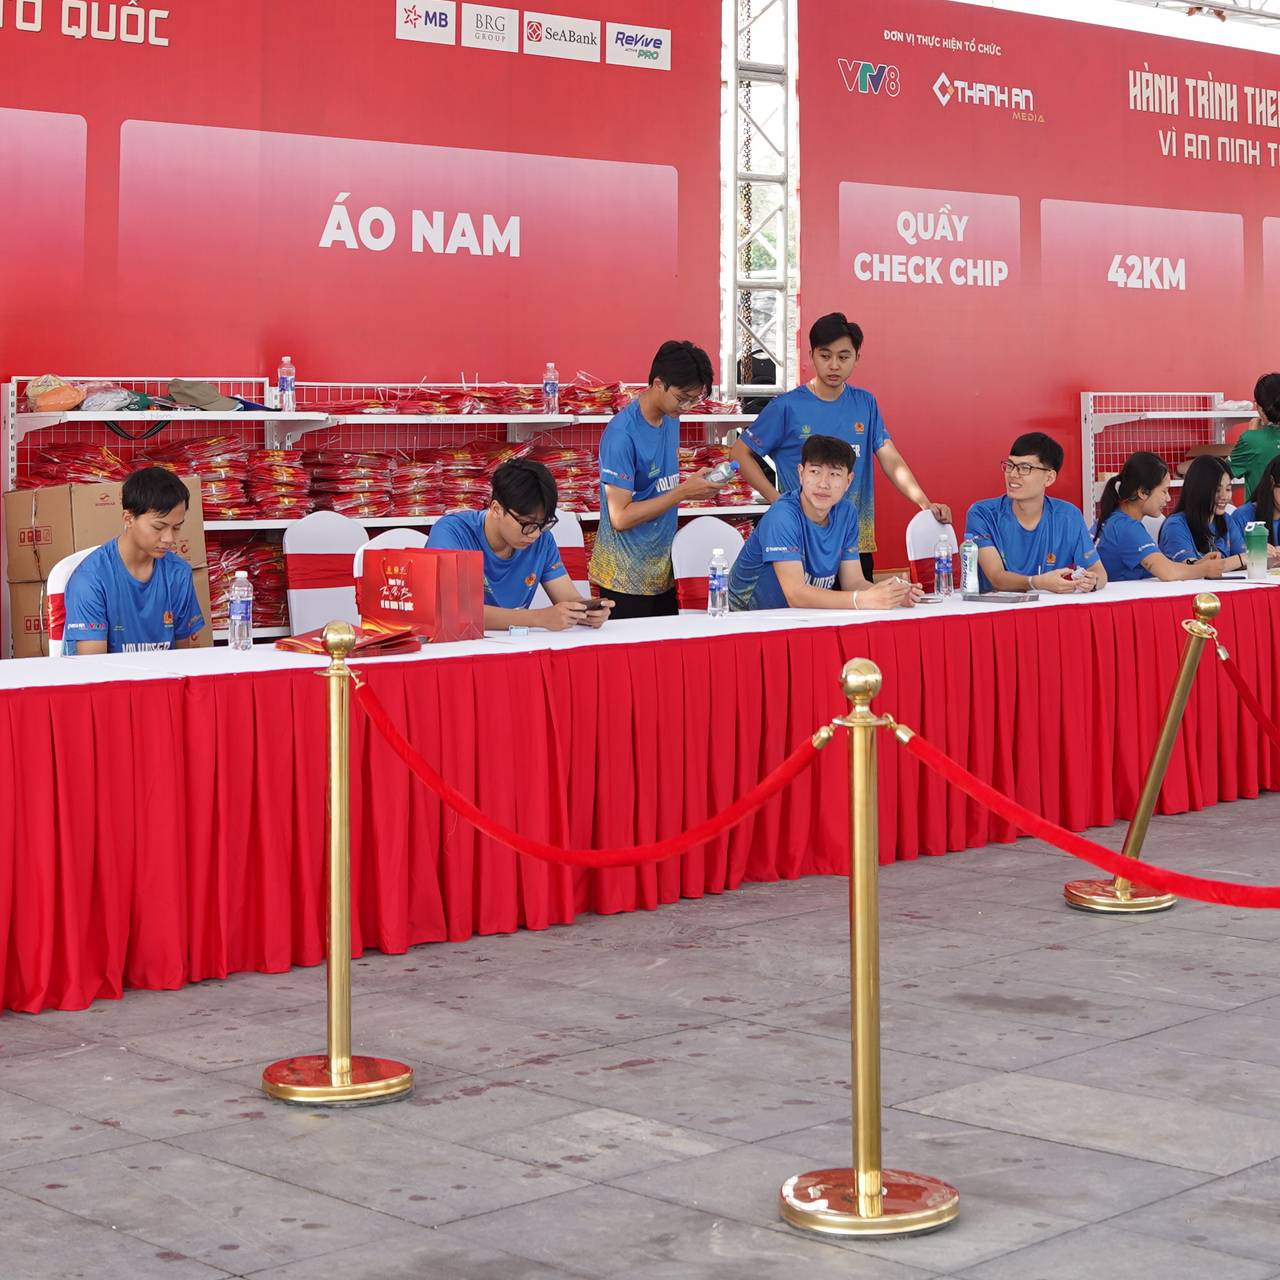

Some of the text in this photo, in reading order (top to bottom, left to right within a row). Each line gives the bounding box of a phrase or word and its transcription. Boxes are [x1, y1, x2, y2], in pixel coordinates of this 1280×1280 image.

[424, 10, 448, 28] MB
[475, 14, 505, 32] BRG
[545, 27, 597, 46] SeABank
[884, 30, 903, 41] ĐƠN
[917, 34, 941, 48] THỰC
[942, 37, 962, 52] HIỆN
[964, 37, 976, 52] TỔ
[978, 41, 1002, 56] CHỨC
[637, 49, 659, 60] PRO
[838, 58, 901, 97] VTV8
[1128, 62, 1179, 116] HÀNH
[1184, 70, 1238, 122] TRÌNH
[953, 80, 1033, 111] THANH AN
[1013, 111, 1045, 122] MEDIA
[1158, 126, 1177, 157] VÌ
[1184, 133, 1210, 160] AN
[1217, 137, 1260, 166] NINH
[318, 192, 520, 257] ÁO NAM
[896, 203, 969, 245] QUẦY
[853, 252, 1009, 287] CHECK CHIP
[1107, 254, 1186, 291] 42KM
